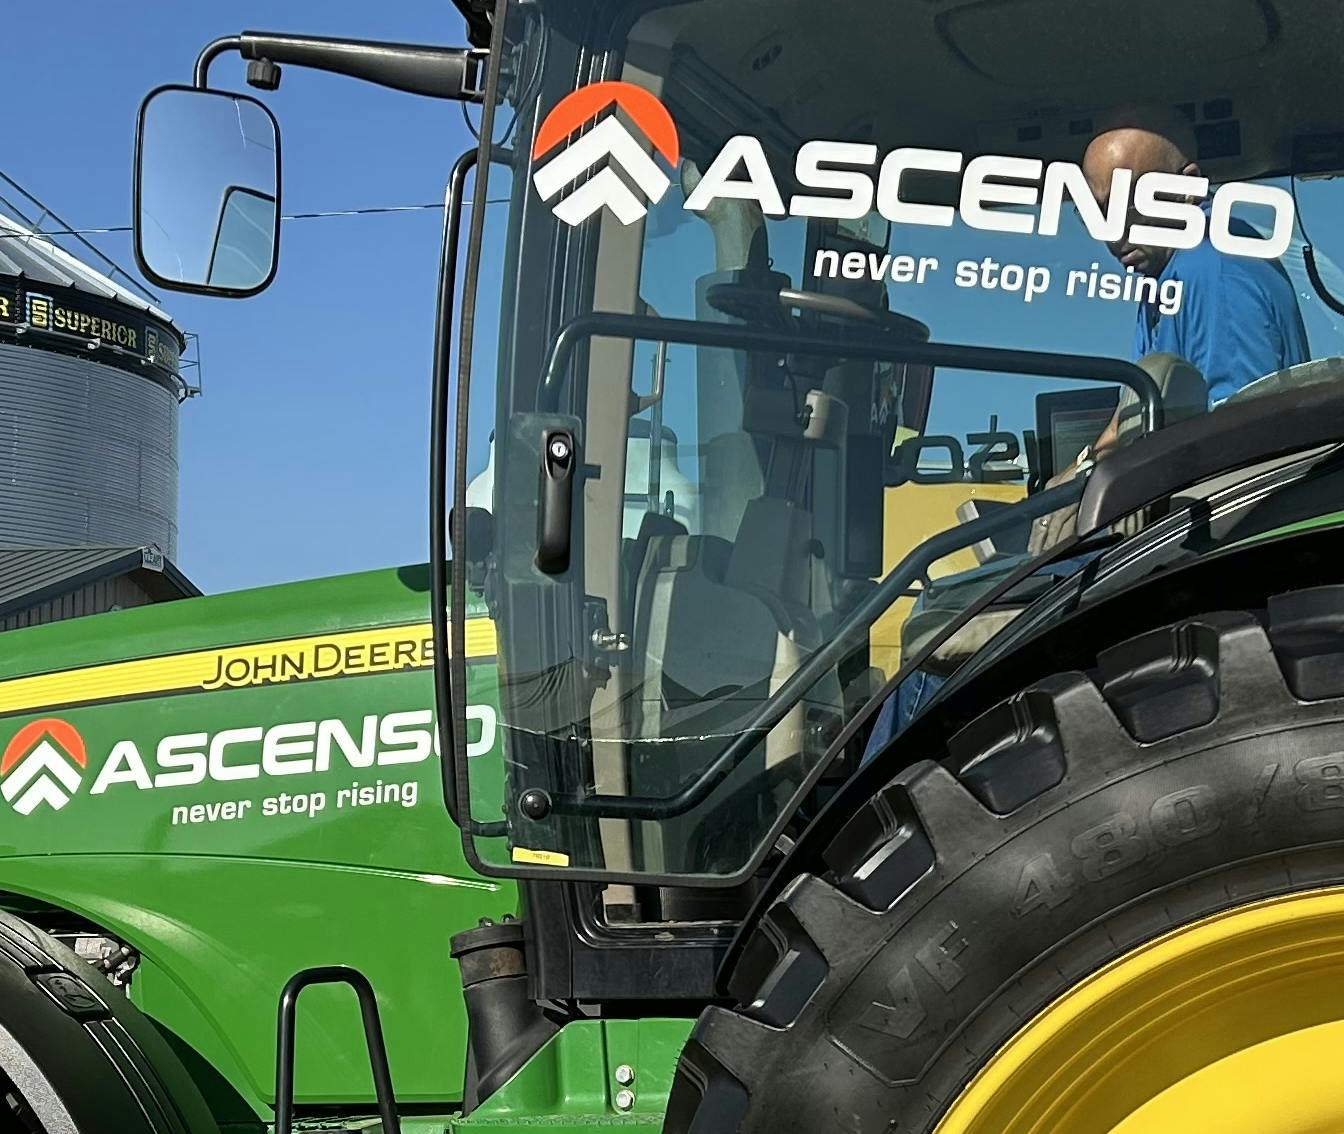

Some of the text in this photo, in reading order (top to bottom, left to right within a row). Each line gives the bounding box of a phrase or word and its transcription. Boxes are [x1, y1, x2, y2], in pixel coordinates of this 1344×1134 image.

[683, 134, 1296, 260] ASCENSO
[813, 247, 1184, 316] never stop rising
[54, 307, 137, 350] SUPERIOR
[202, 648, 307, 688] JOHN
[171, 779, 419, 826] never stop rising
[866, 920, 974, 1041] VF
